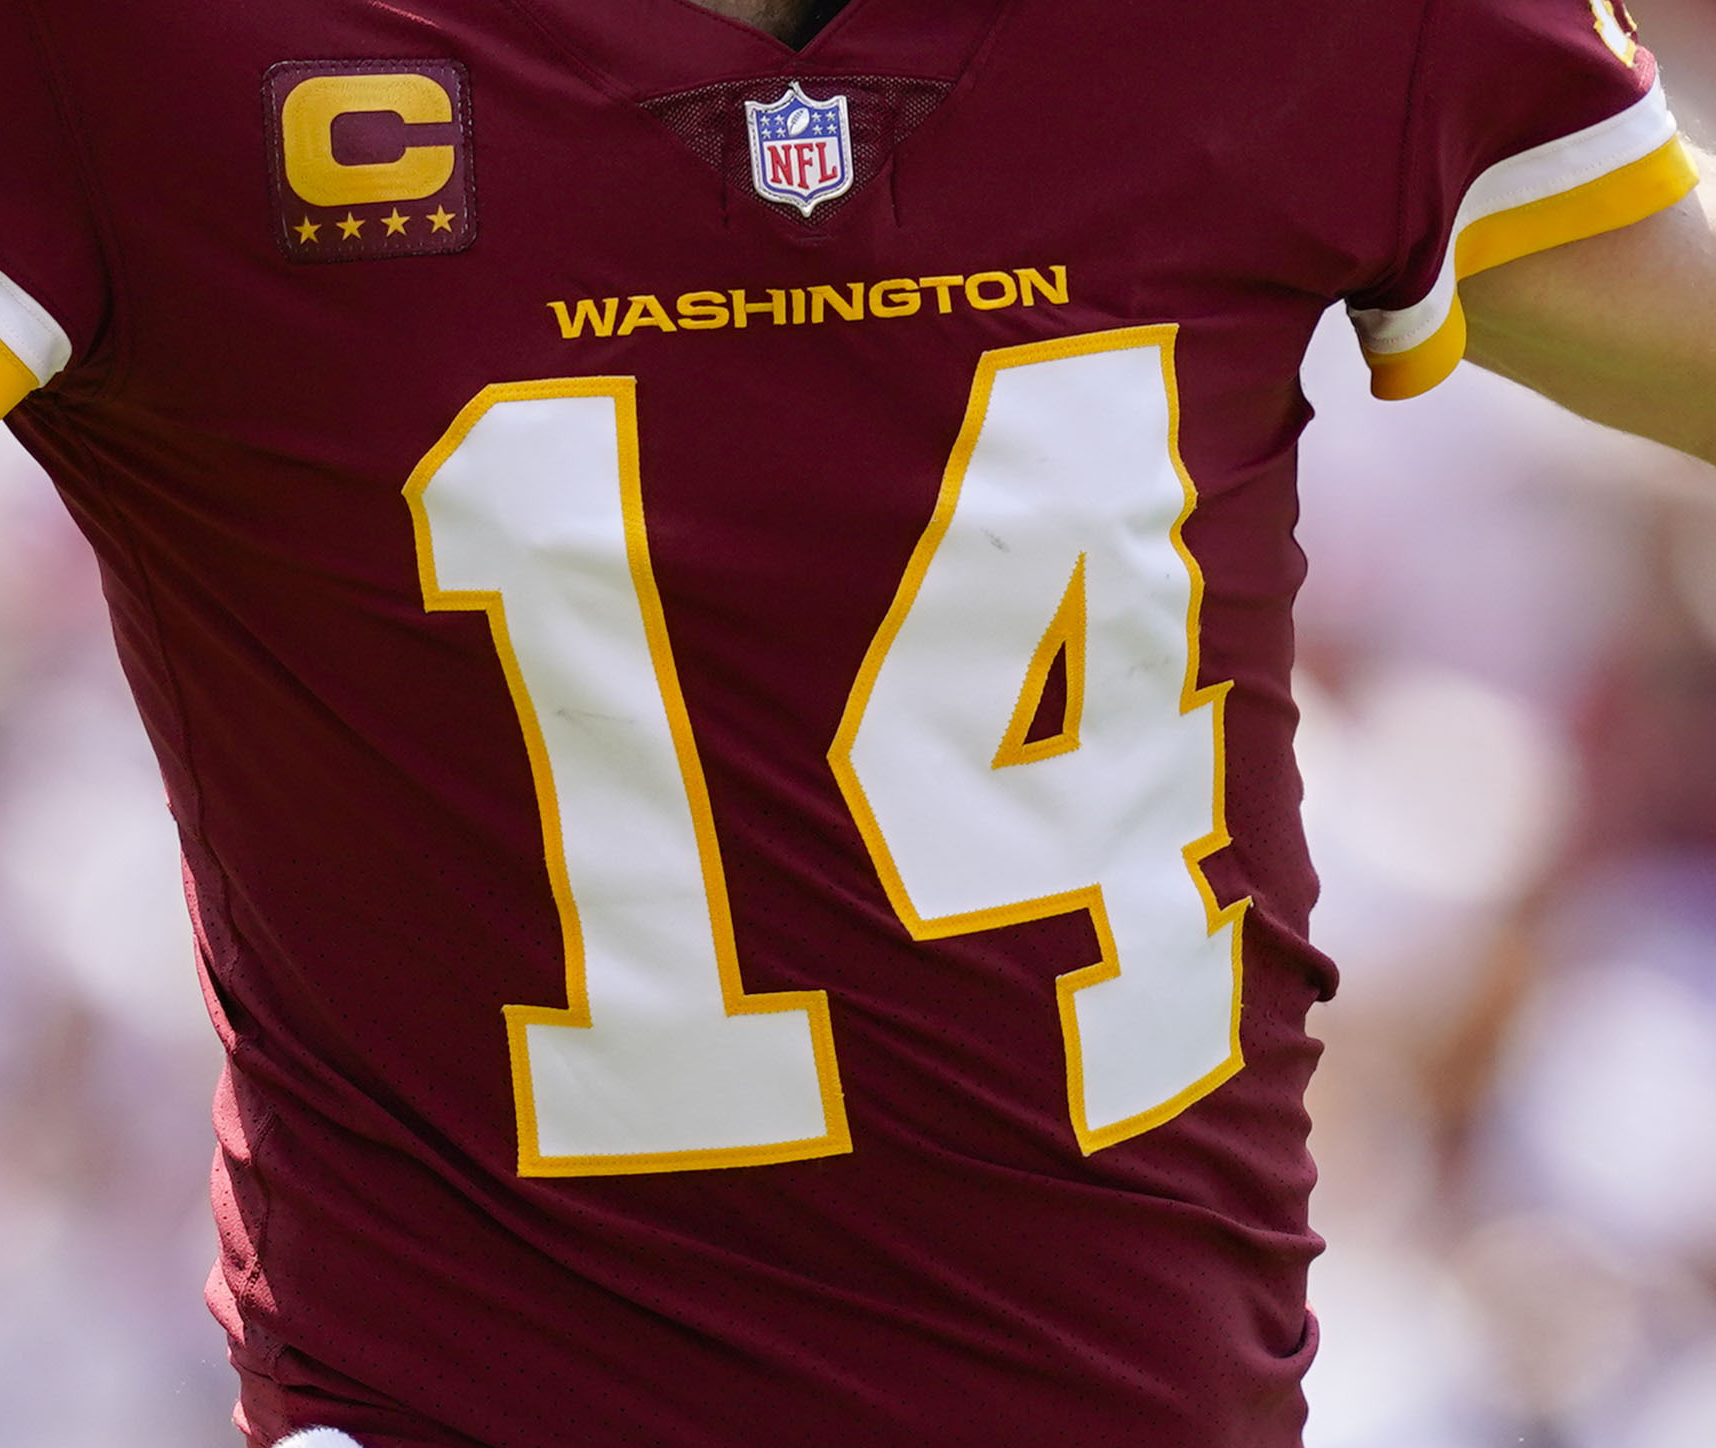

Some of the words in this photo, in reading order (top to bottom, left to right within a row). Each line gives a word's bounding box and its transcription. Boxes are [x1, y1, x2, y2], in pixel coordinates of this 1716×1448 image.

[282, 73, 456, 206] C
[766, 139, 840, 192] NFL
[546, 264, 1070, 341] WASHINGTON
[402, 324, 1251, 1178] 14
